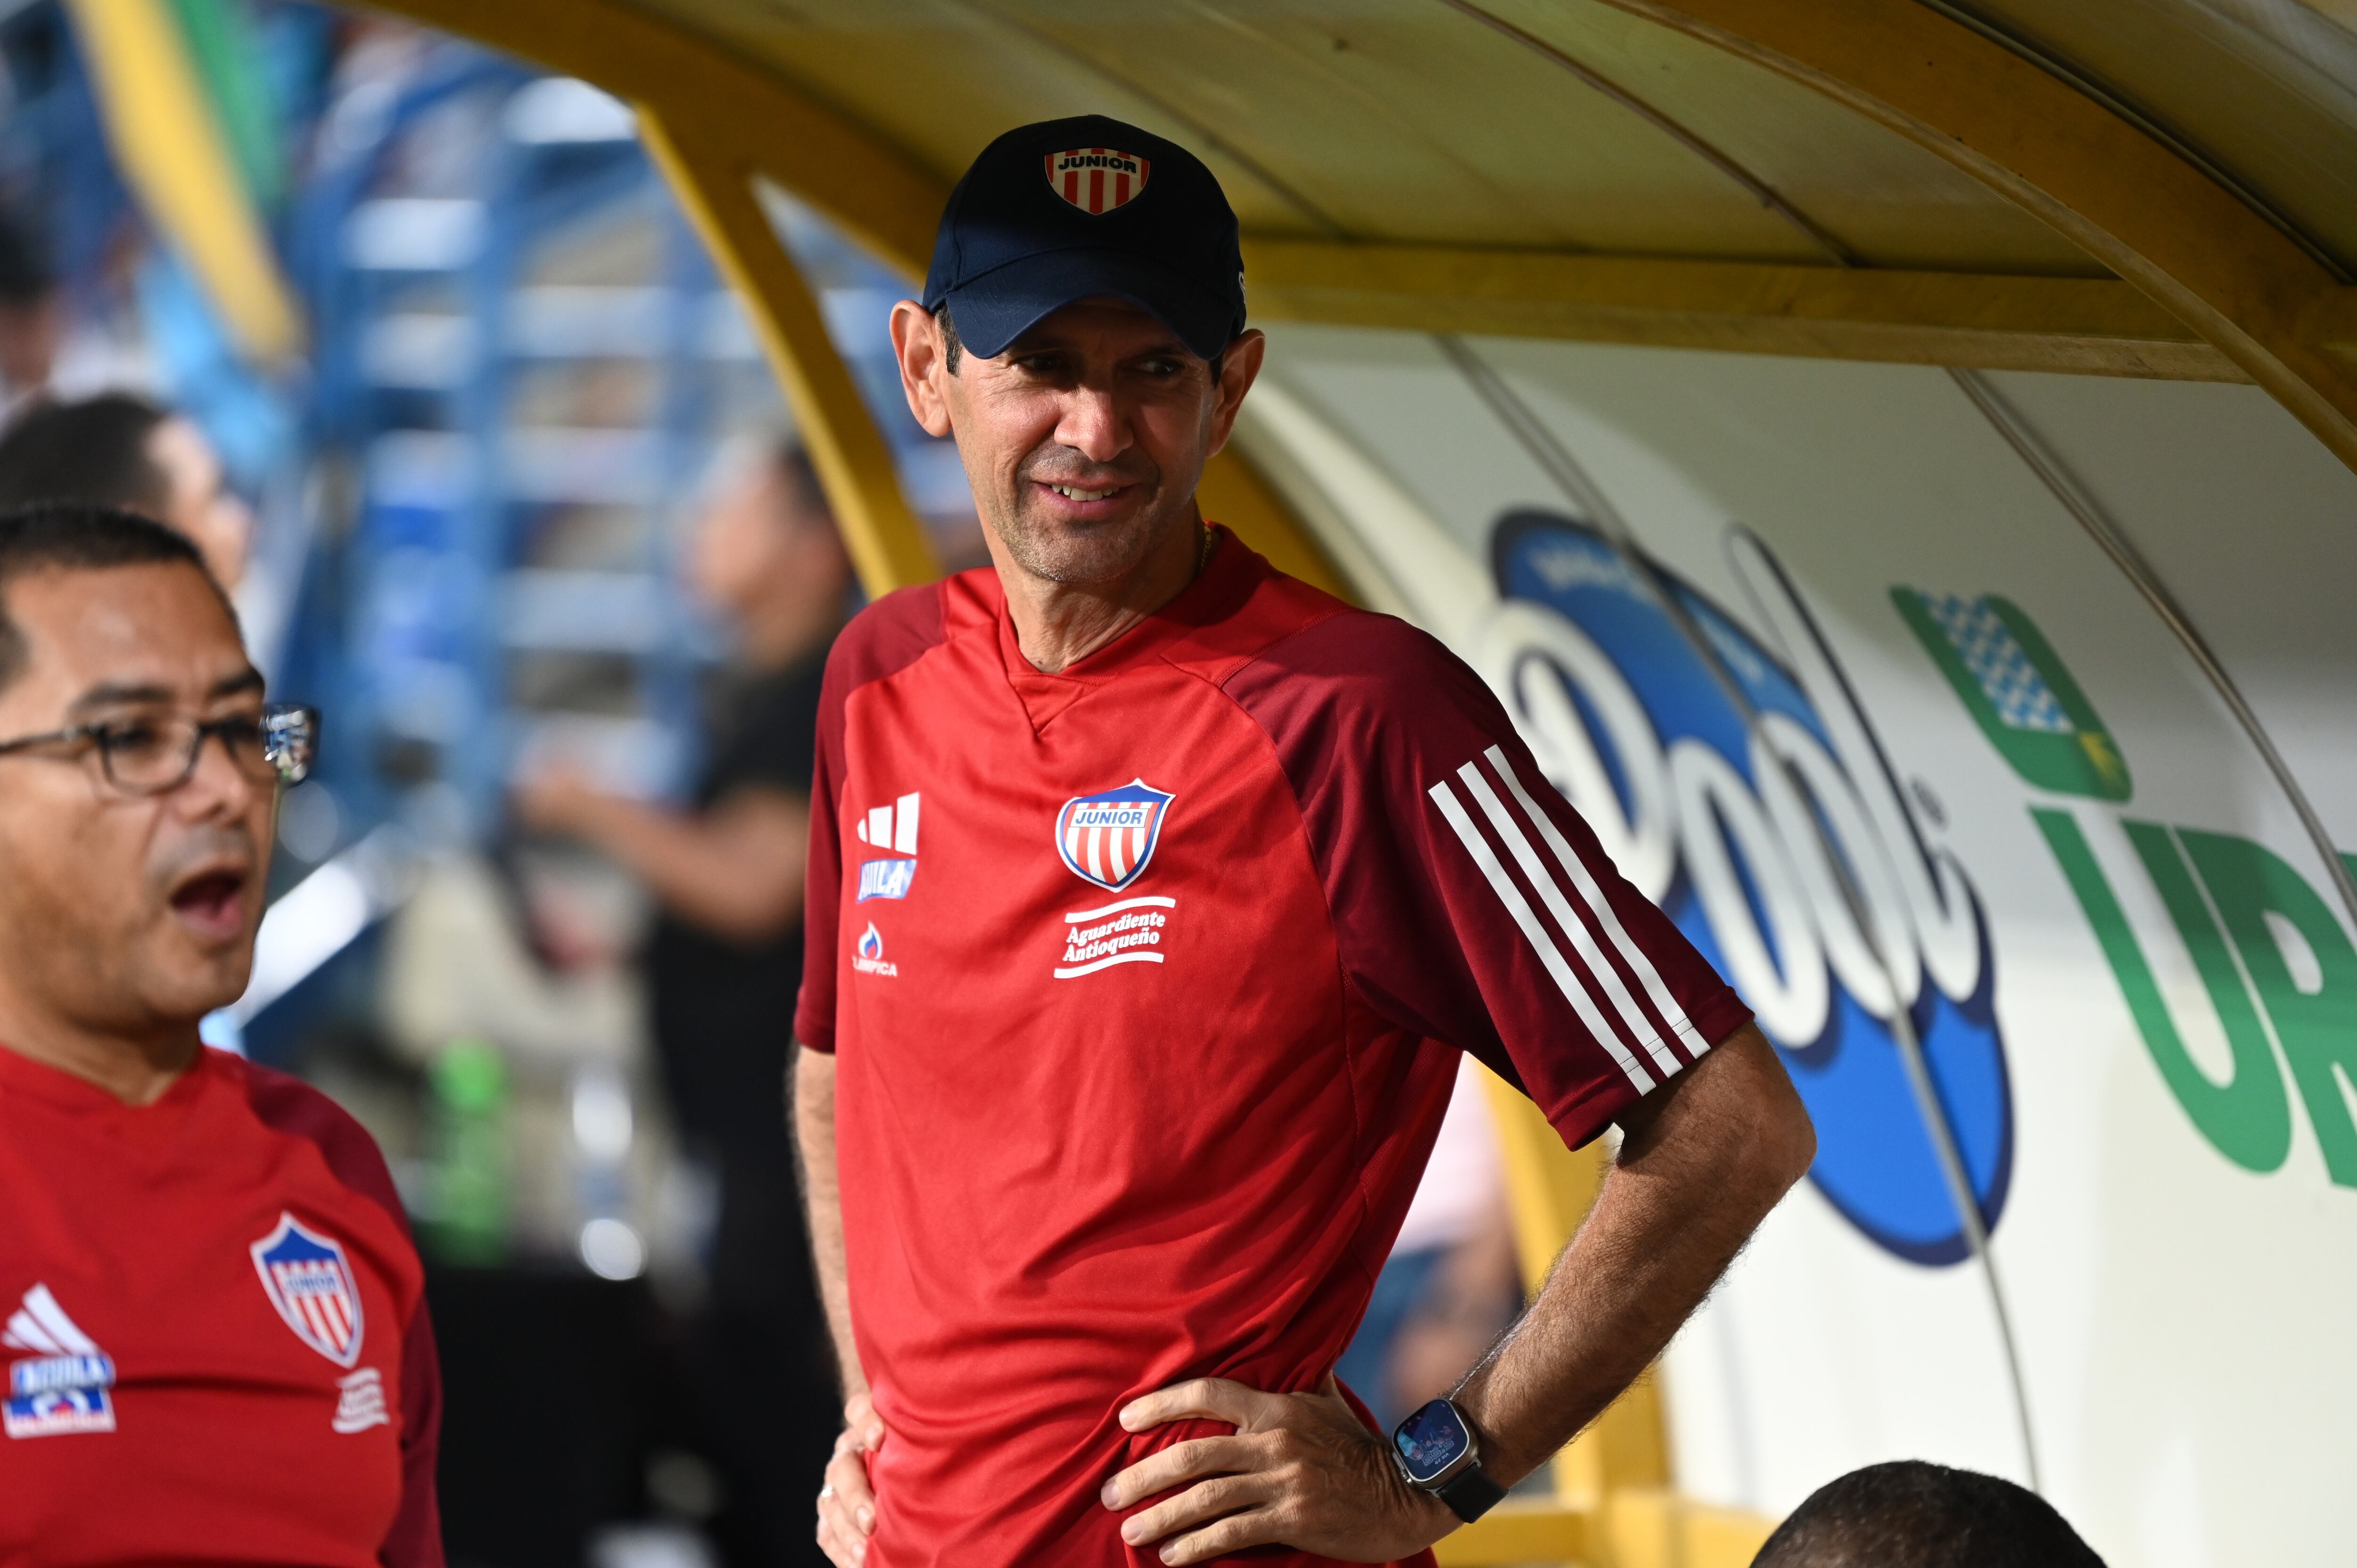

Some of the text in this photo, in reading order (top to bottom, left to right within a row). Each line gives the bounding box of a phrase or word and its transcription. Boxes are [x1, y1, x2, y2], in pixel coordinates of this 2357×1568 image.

[1058, 155, 1137, 173] JUNIOR
[1075, 811, 1143, 824] JUNIOR
[1062, 927, 1160, 962] Antioqueño
[1066, 911, 1166, 947] Aguardiente
[2028, 803, 2357, 1192] UR
